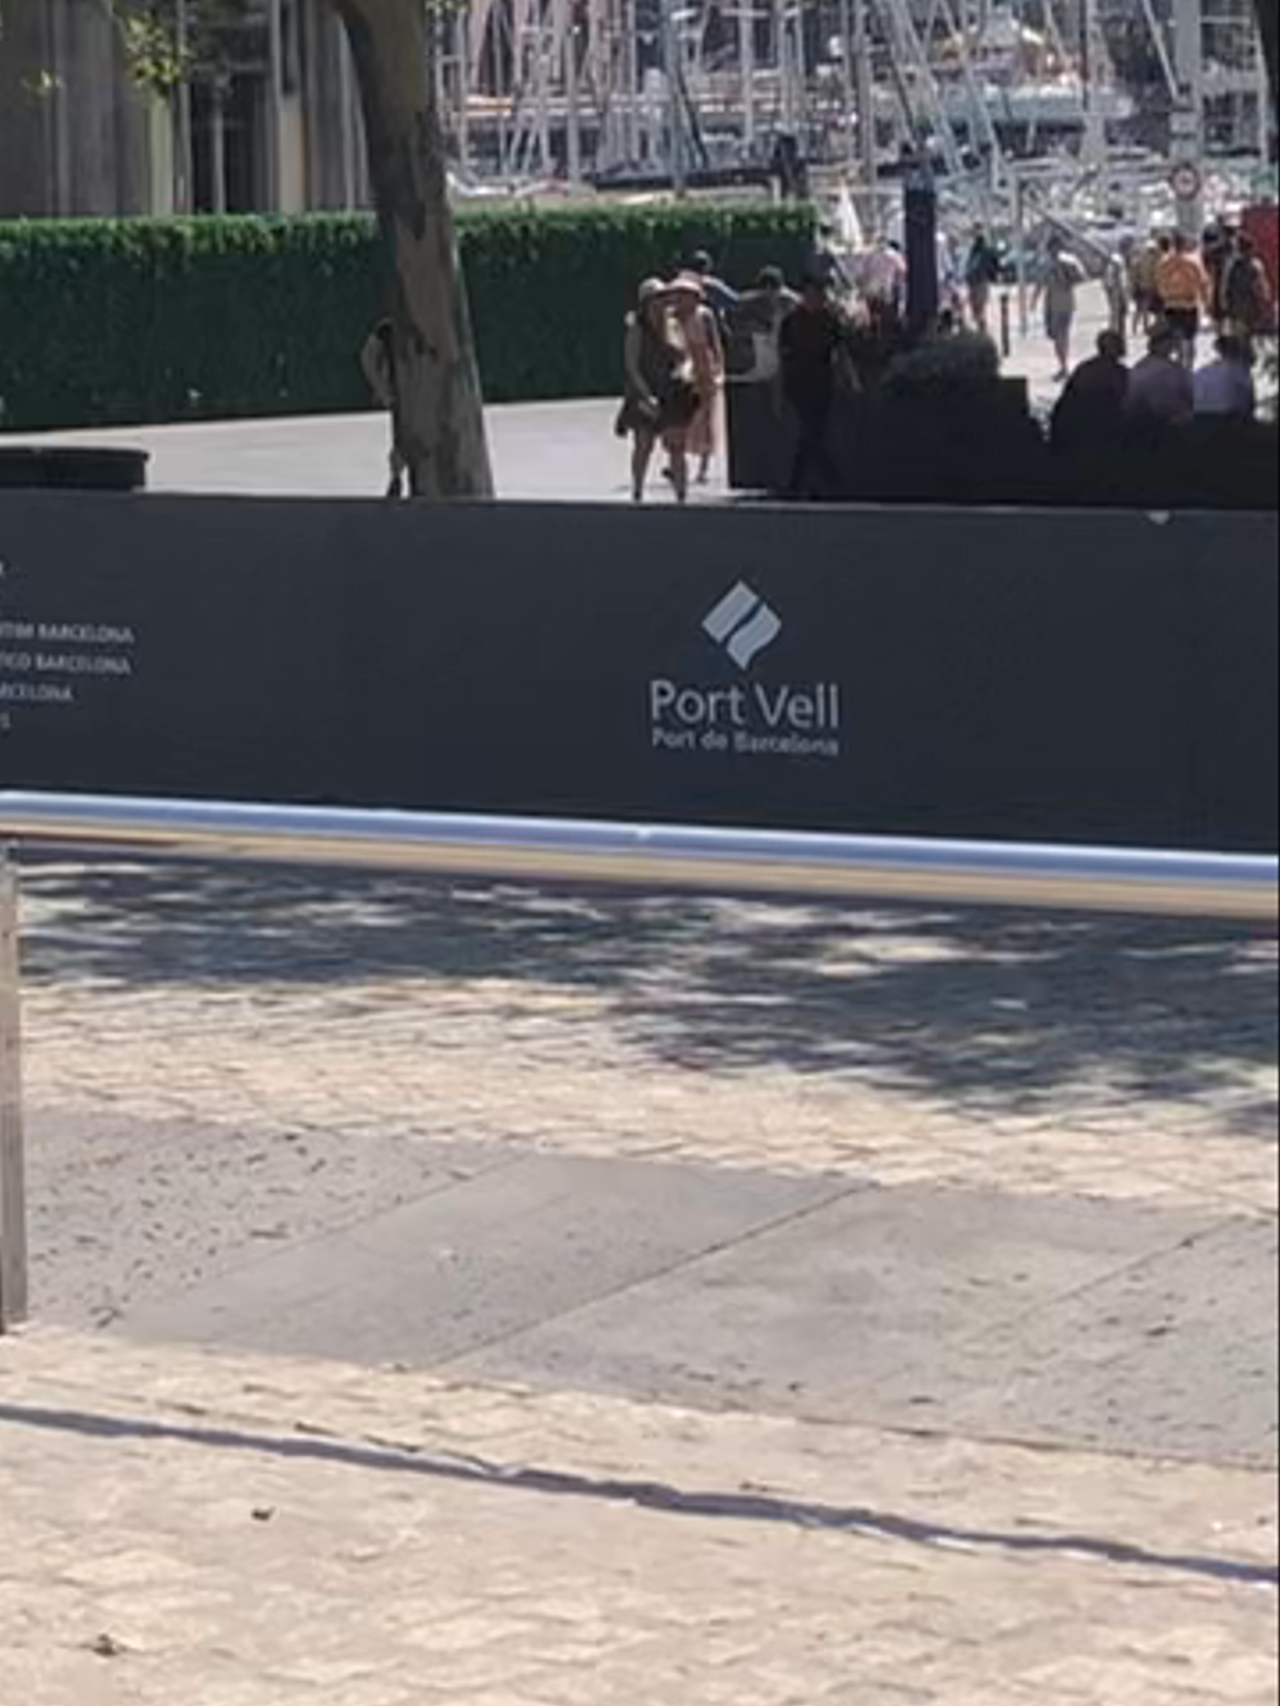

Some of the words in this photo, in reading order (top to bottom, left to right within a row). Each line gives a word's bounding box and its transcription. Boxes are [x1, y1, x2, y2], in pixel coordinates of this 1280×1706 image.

[38, 623, 135, 645] BARCELONA
[36, 653, 132, 675] BARCELONA
[650, 680, 745, 725] Port
[755, 683, 838, 729] Vell
[652, 728, 694, 748] Port
[700, 729, 728, 750] de
[734, 732, 838, 756] Barcelona
